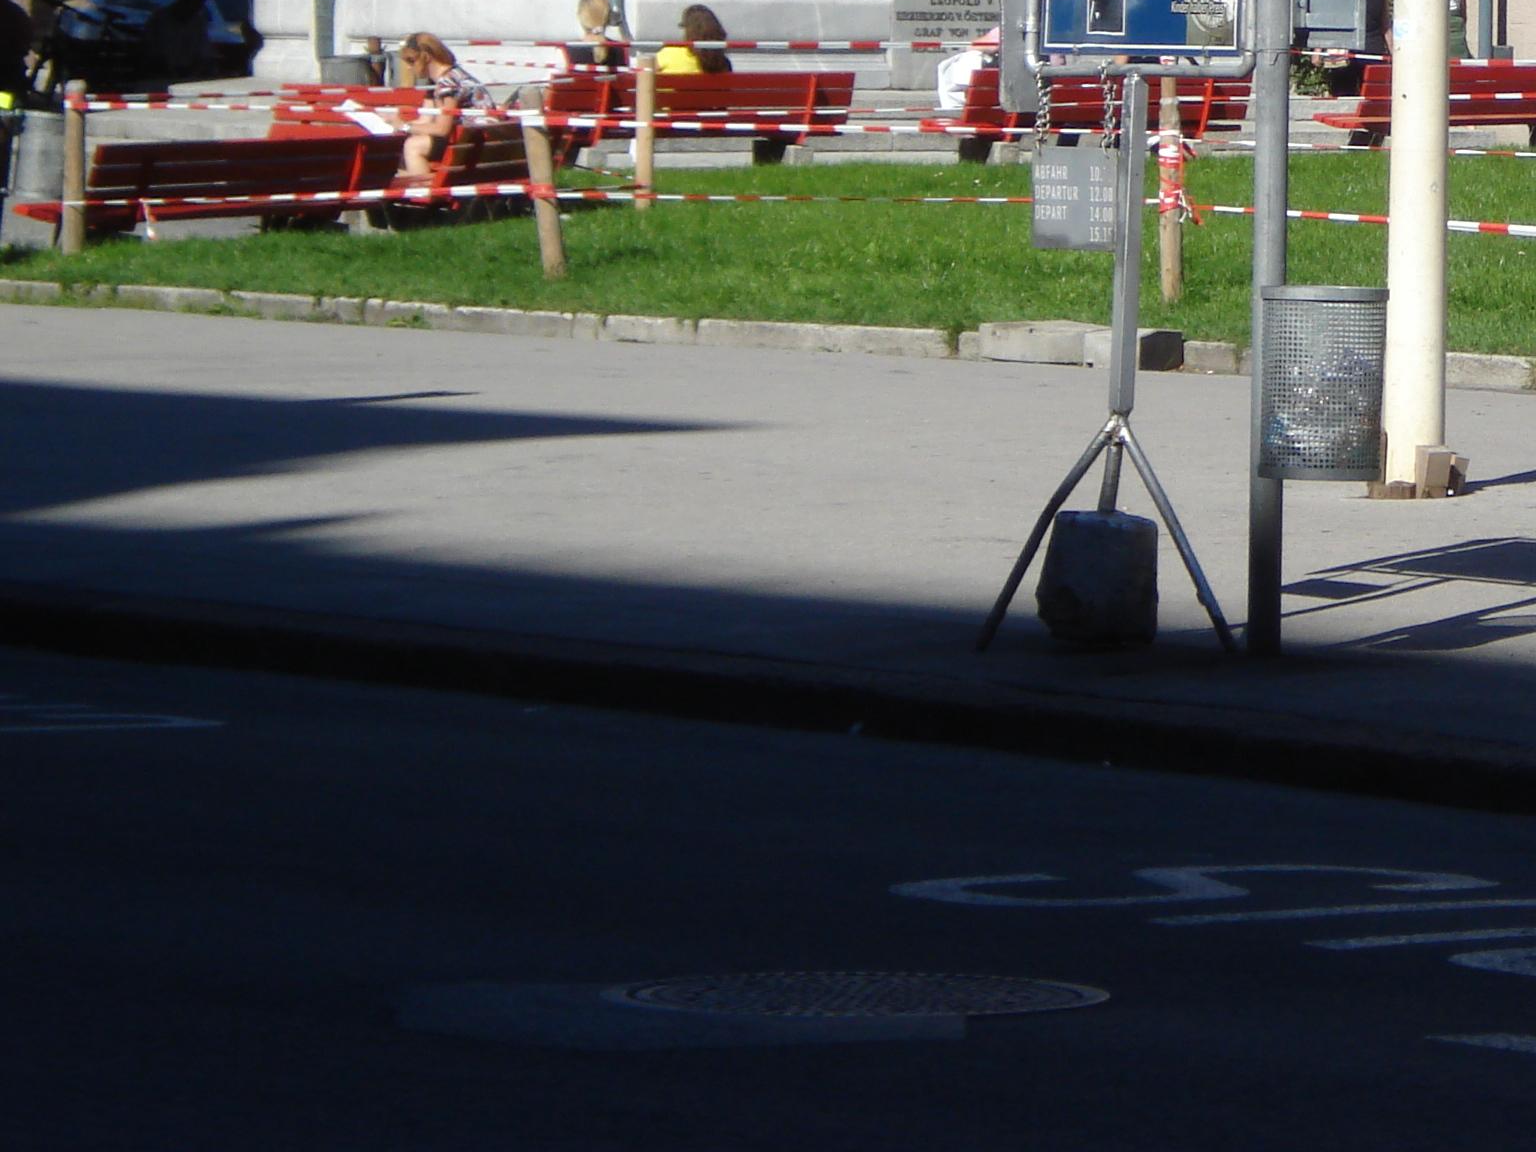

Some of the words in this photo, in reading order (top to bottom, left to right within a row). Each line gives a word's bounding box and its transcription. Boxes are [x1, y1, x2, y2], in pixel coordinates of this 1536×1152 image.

[1090, 187, 1113, 202] 12.00
[1034, 205, 1068, 220] DEPART
[1090, 206, 1113, 222] 14.00
